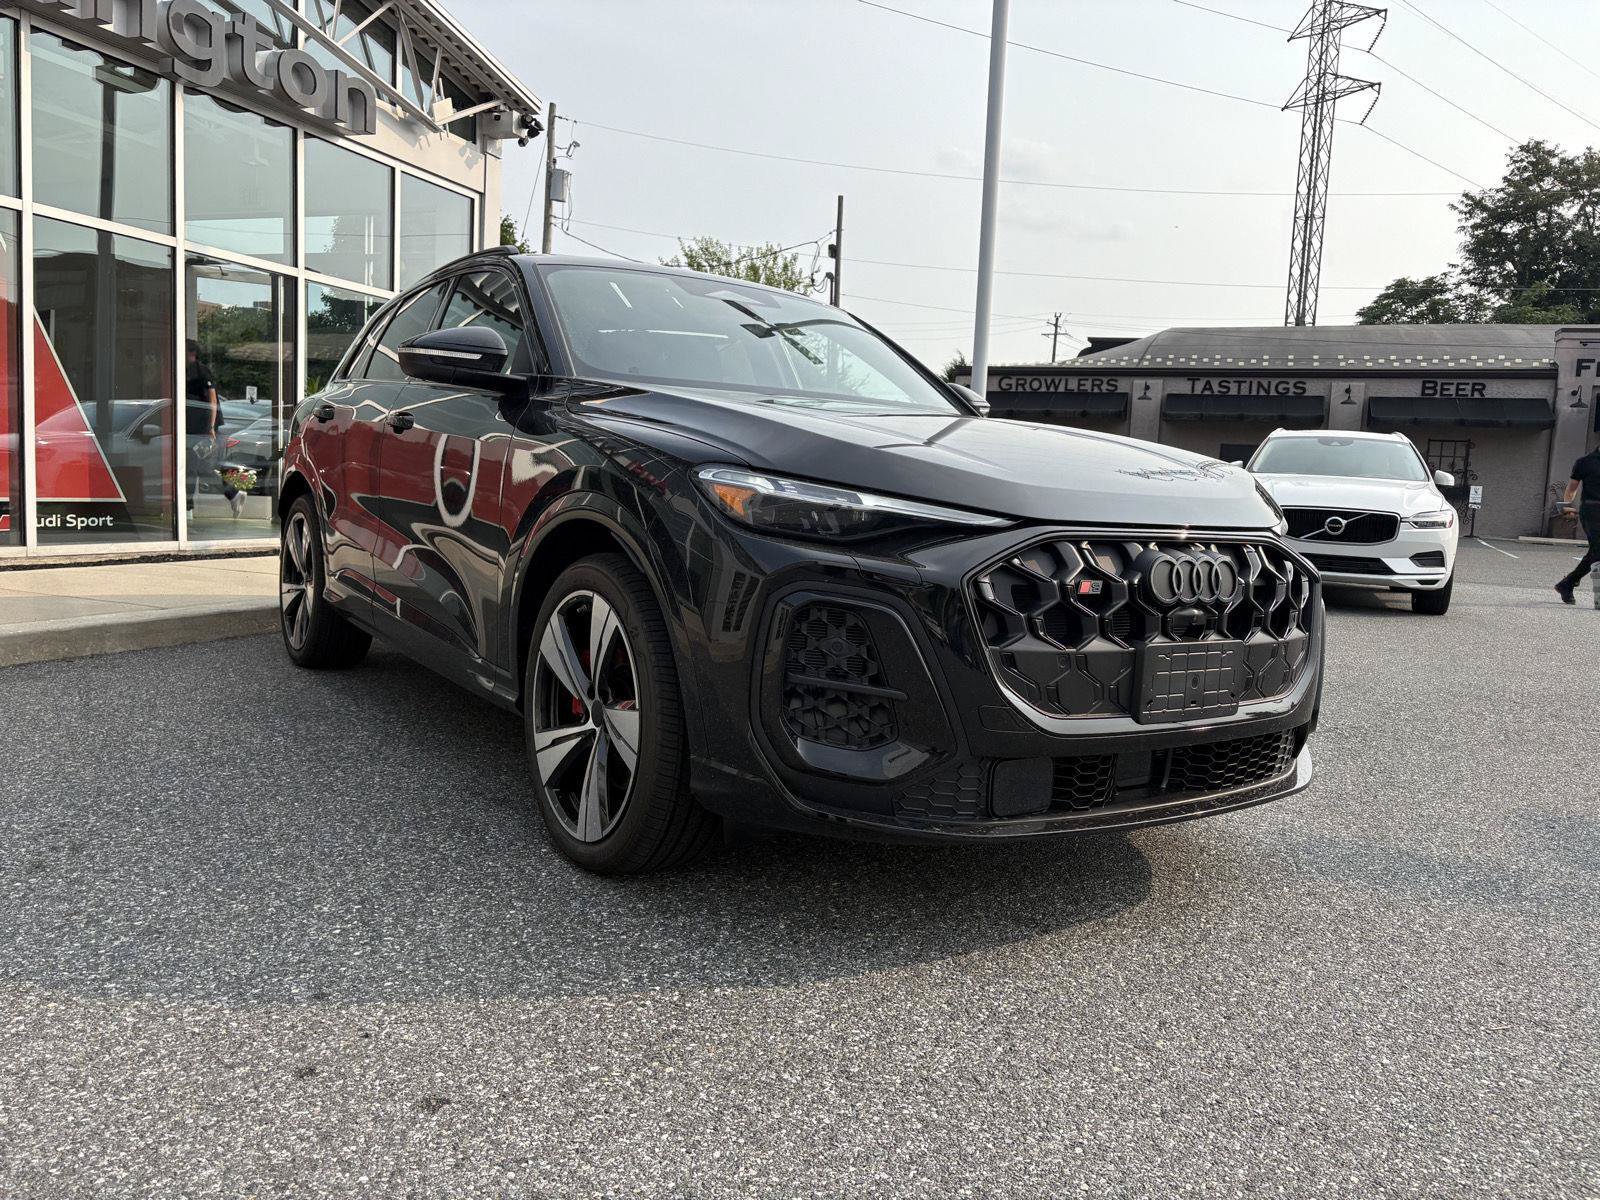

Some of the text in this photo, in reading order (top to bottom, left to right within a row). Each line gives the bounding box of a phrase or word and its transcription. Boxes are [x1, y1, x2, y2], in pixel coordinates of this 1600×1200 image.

[36, 0, 377, 136] gton
[1576, 358, 1600, 377] F
[998, 376, 1119, 392] GROWLERS
[1187, 377, 1307, 395] TASTINGS
[1421, 380, 1487, 397] BEER
[36, 514, 113, 529] udi Sport
